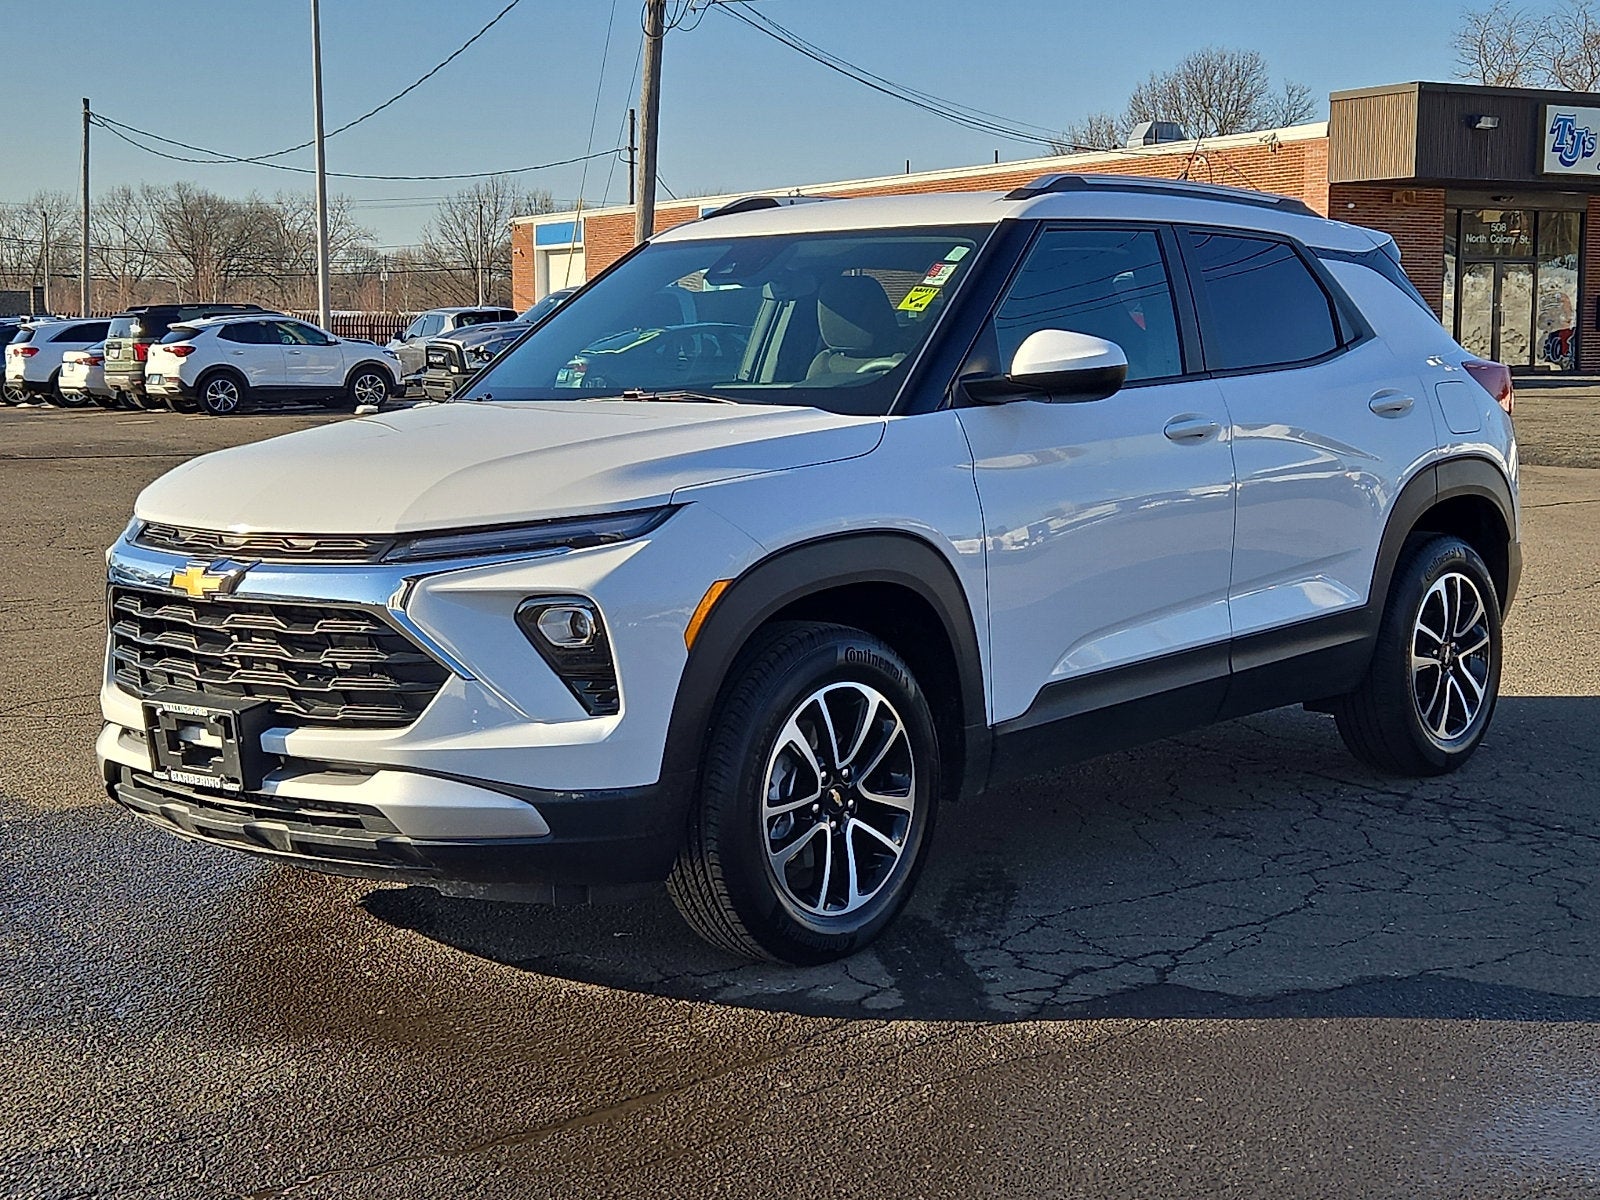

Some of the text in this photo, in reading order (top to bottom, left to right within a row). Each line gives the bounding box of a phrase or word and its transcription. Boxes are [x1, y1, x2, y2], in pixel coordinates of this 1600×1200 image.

[1549, 113, 1597, 167] TJ's
[1490, 223, 1507, 232] 508
[1466, 234, 1530, 245] North Colony St.
[844, 647, 903, 682] Continental
[171, 770, 221, 788] BARBERINO
